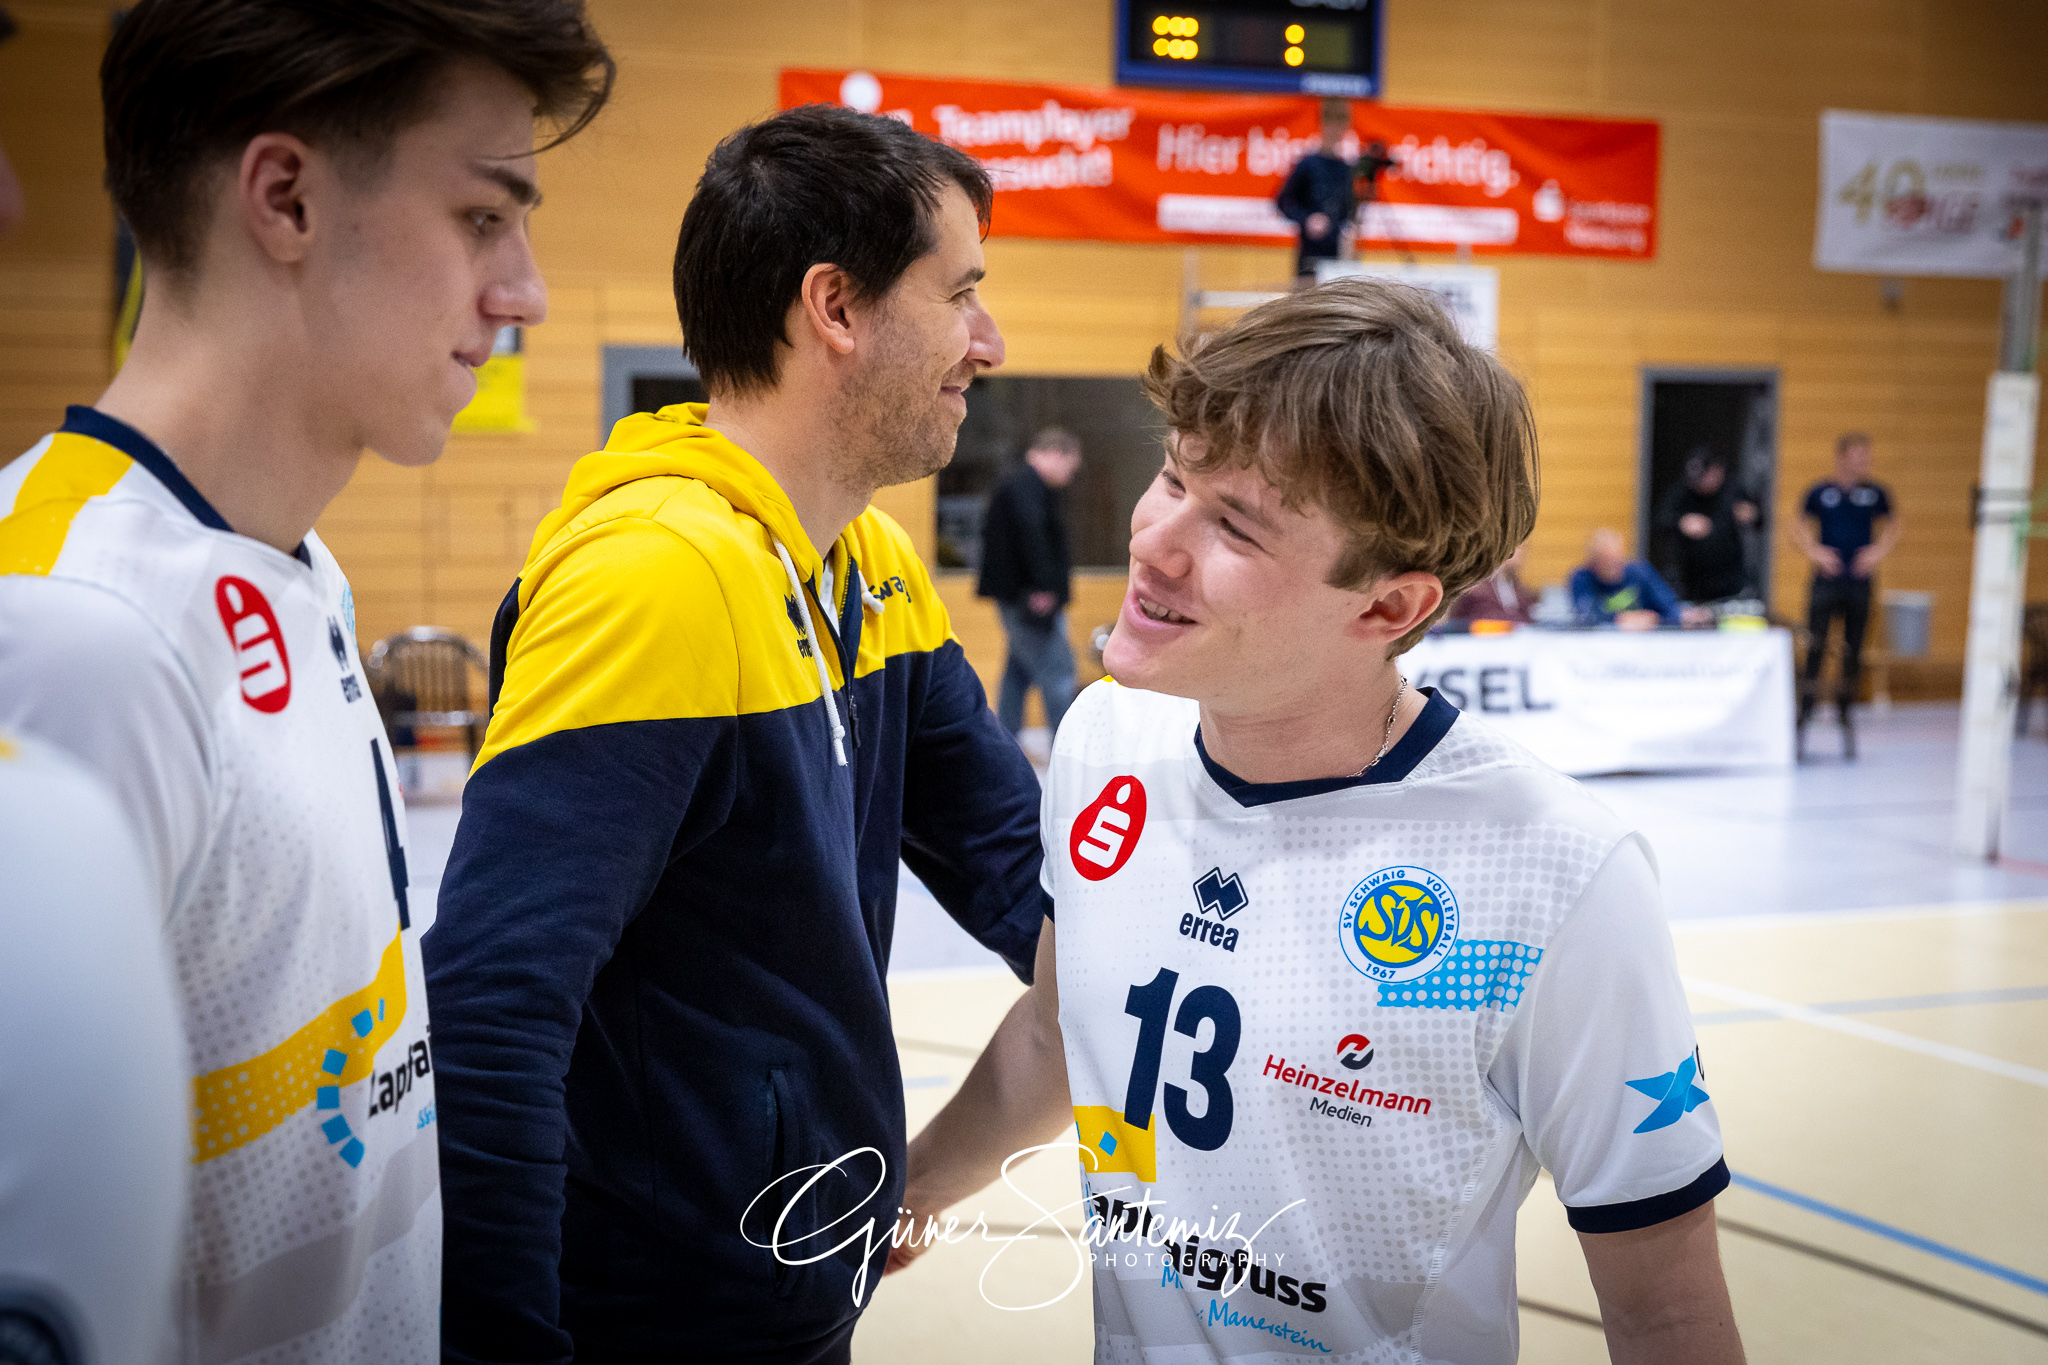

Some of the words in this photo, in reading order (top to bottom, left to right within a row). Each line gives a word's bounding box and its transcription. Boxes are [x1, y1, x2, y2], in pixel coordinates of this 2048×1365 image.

[1179, 912, 1239, 953] errea
[1343, 912, 1353, 928] SV
[1349, 869, 1406, 908] SCHWAIG
[1426, 876, 1455, 957] VOLLEYBALL
[1365, 963, 1397, 980] 1967
[1124, 967, 1242, 1152] 13
[1262, 1054, 1432, 1115] Heinzelmann
[1309, 1096, 1373, 1128] Medien
